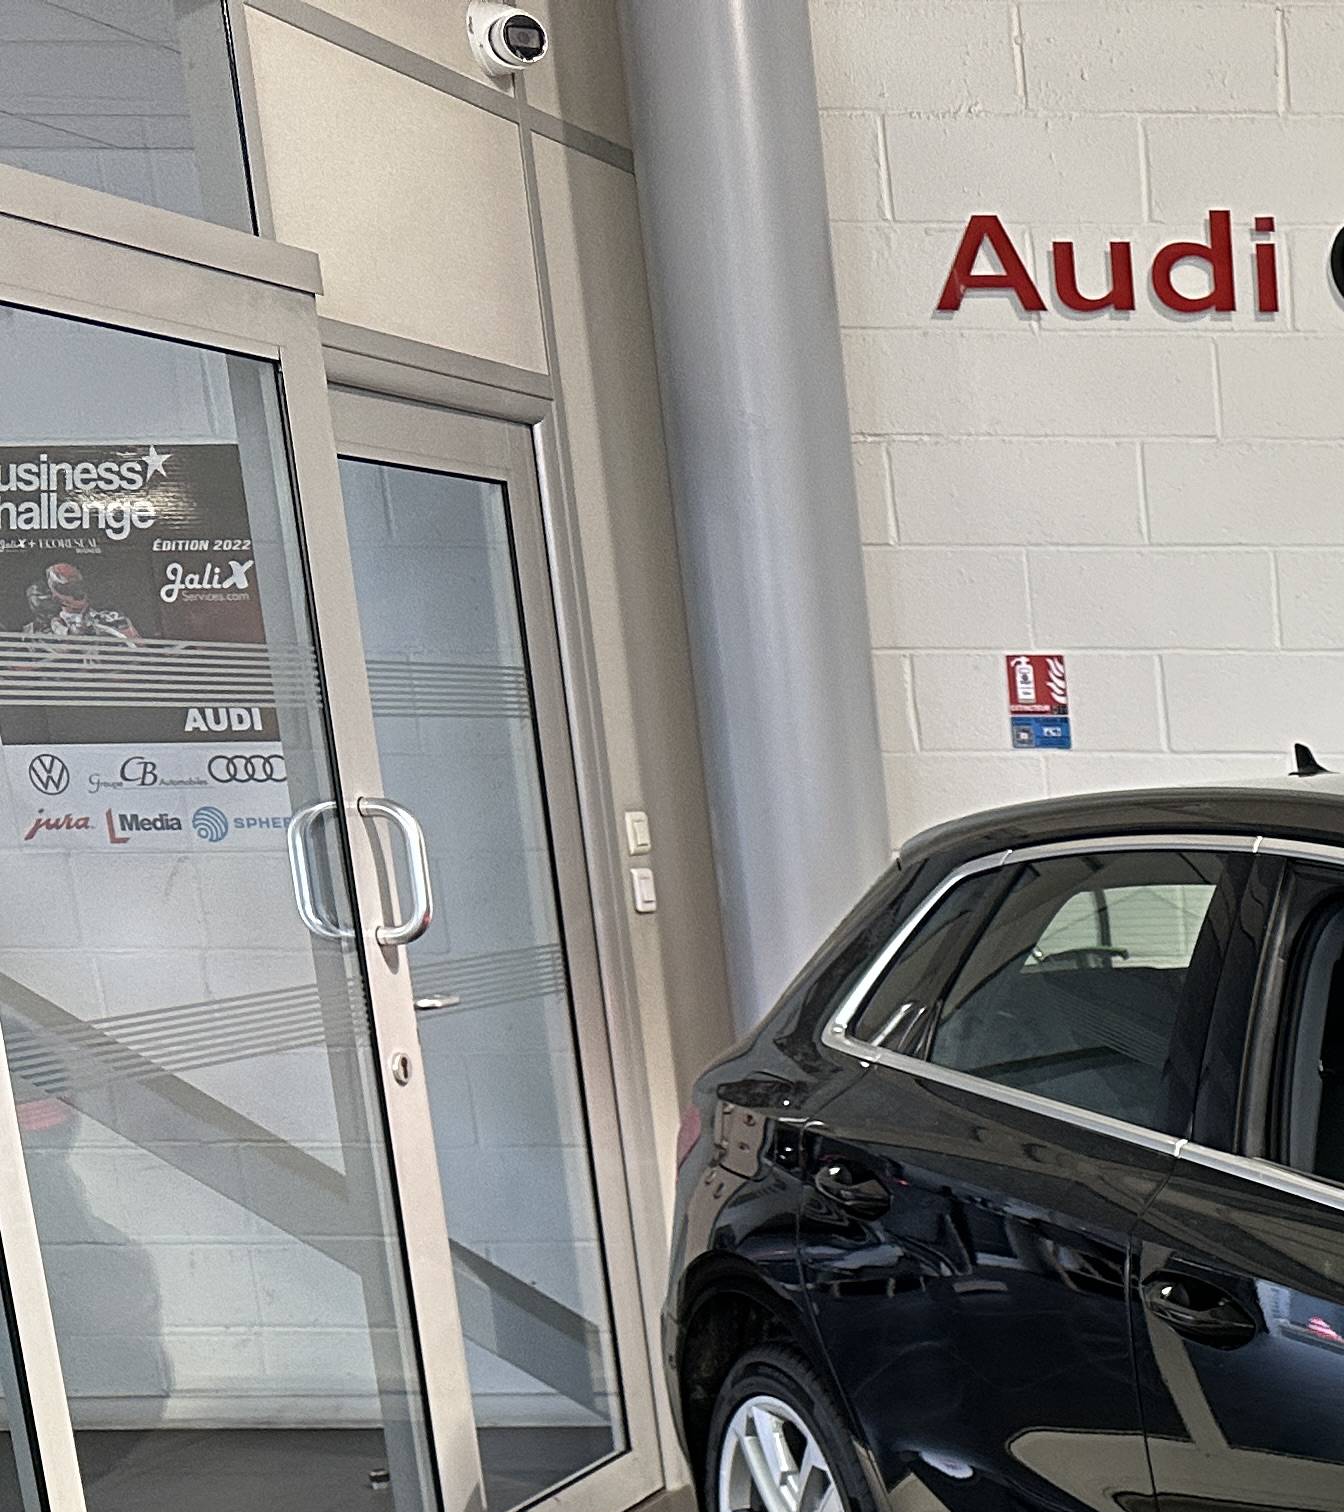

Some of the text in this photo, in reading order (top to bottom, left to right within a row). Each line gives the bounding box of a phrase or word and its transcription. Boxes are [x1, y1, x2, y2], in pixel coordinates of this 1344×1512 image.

[933, 208, 1280, 314] Audi
[152, 539, 252, 551] ÉDITION 2022
[184, 707, 263, 732] AUDI
[120, 756, 158, 786] CB
[24, 809, 91, 841] jura
